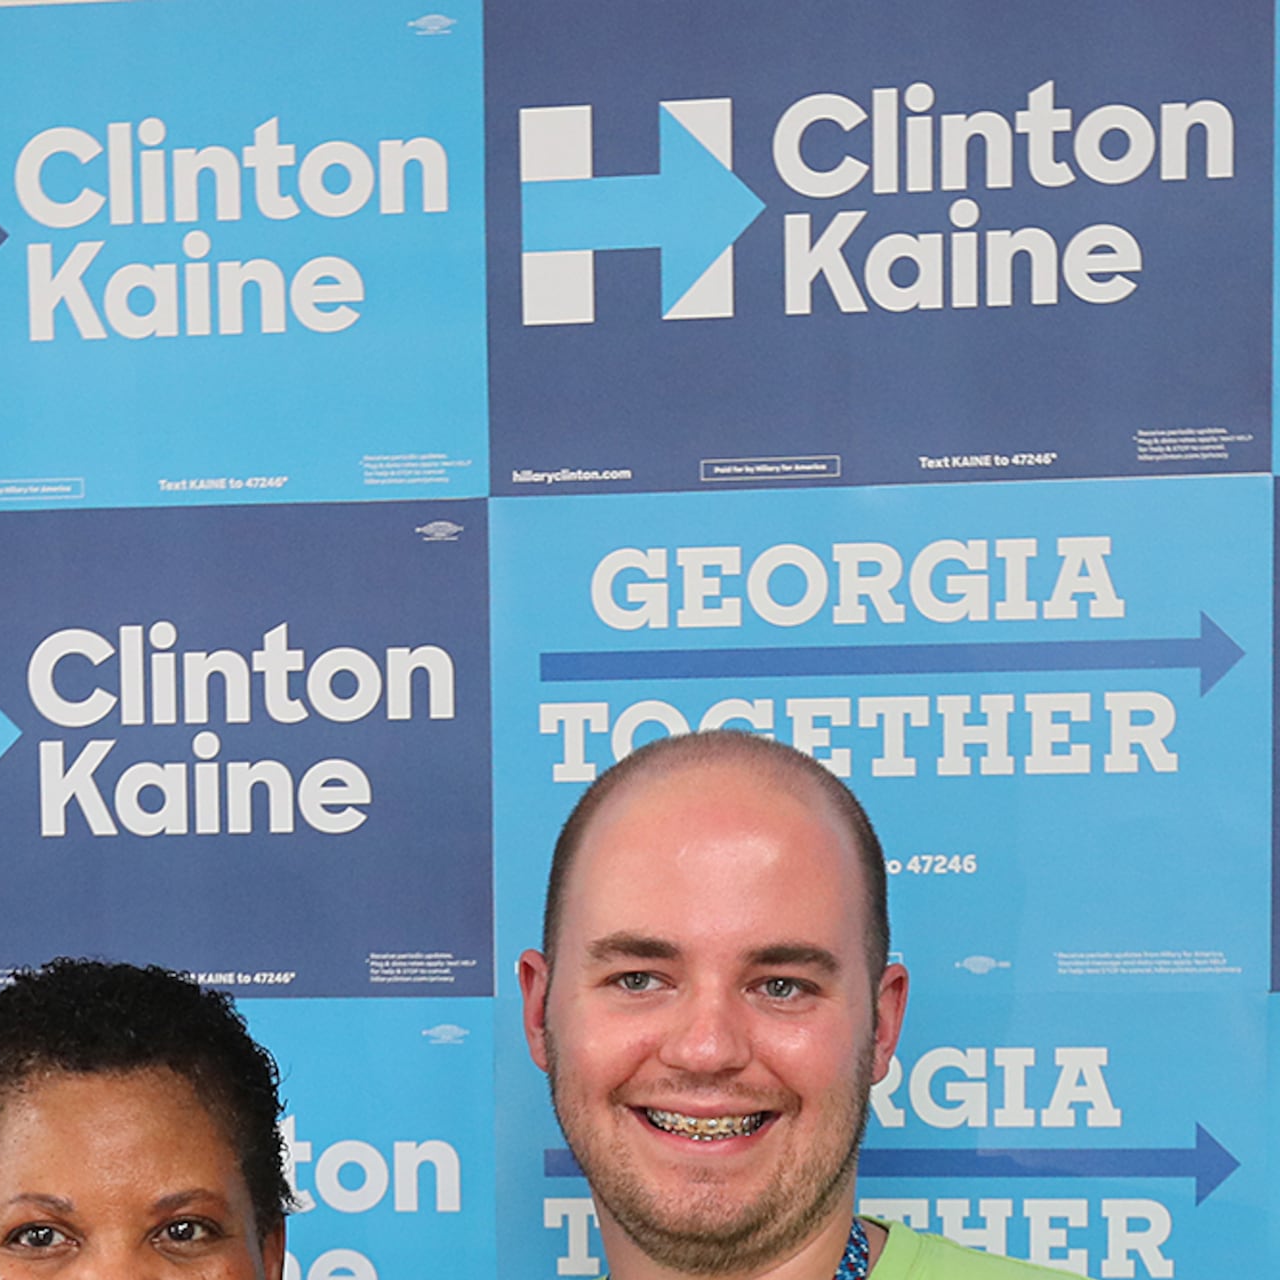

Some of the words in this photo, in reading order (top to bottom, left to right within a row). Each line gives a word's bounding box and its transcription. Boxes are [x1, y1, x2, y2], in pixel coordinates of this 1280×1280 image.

[15, 117, 448, 228] Clinton
[773, 81, 1233, 197] Clinton
[27, 230, 364, 341] Kaine
[785, 199, 1141, 314] Kaine
[158, 478, 188, 491] Text
[189, 477, 227, 490] KAINE
[228, 476, 244, 489] to
[512, 466, 631, 485] hillaryclinton.com
[918, 455, 950, 469] Text
[951, 453, 991, 468] KAINE
[993, 453, 1010, 466] to
[590, 536, 1125, 630] GEORGIA
[28, 622, 454, 727] Clinton
[40, 732, 371, 836] Kaine
[906, 854, 977, 874] 47246
[197, 971, 235, 984] KAINE
[236, 971, 252, 984] to
